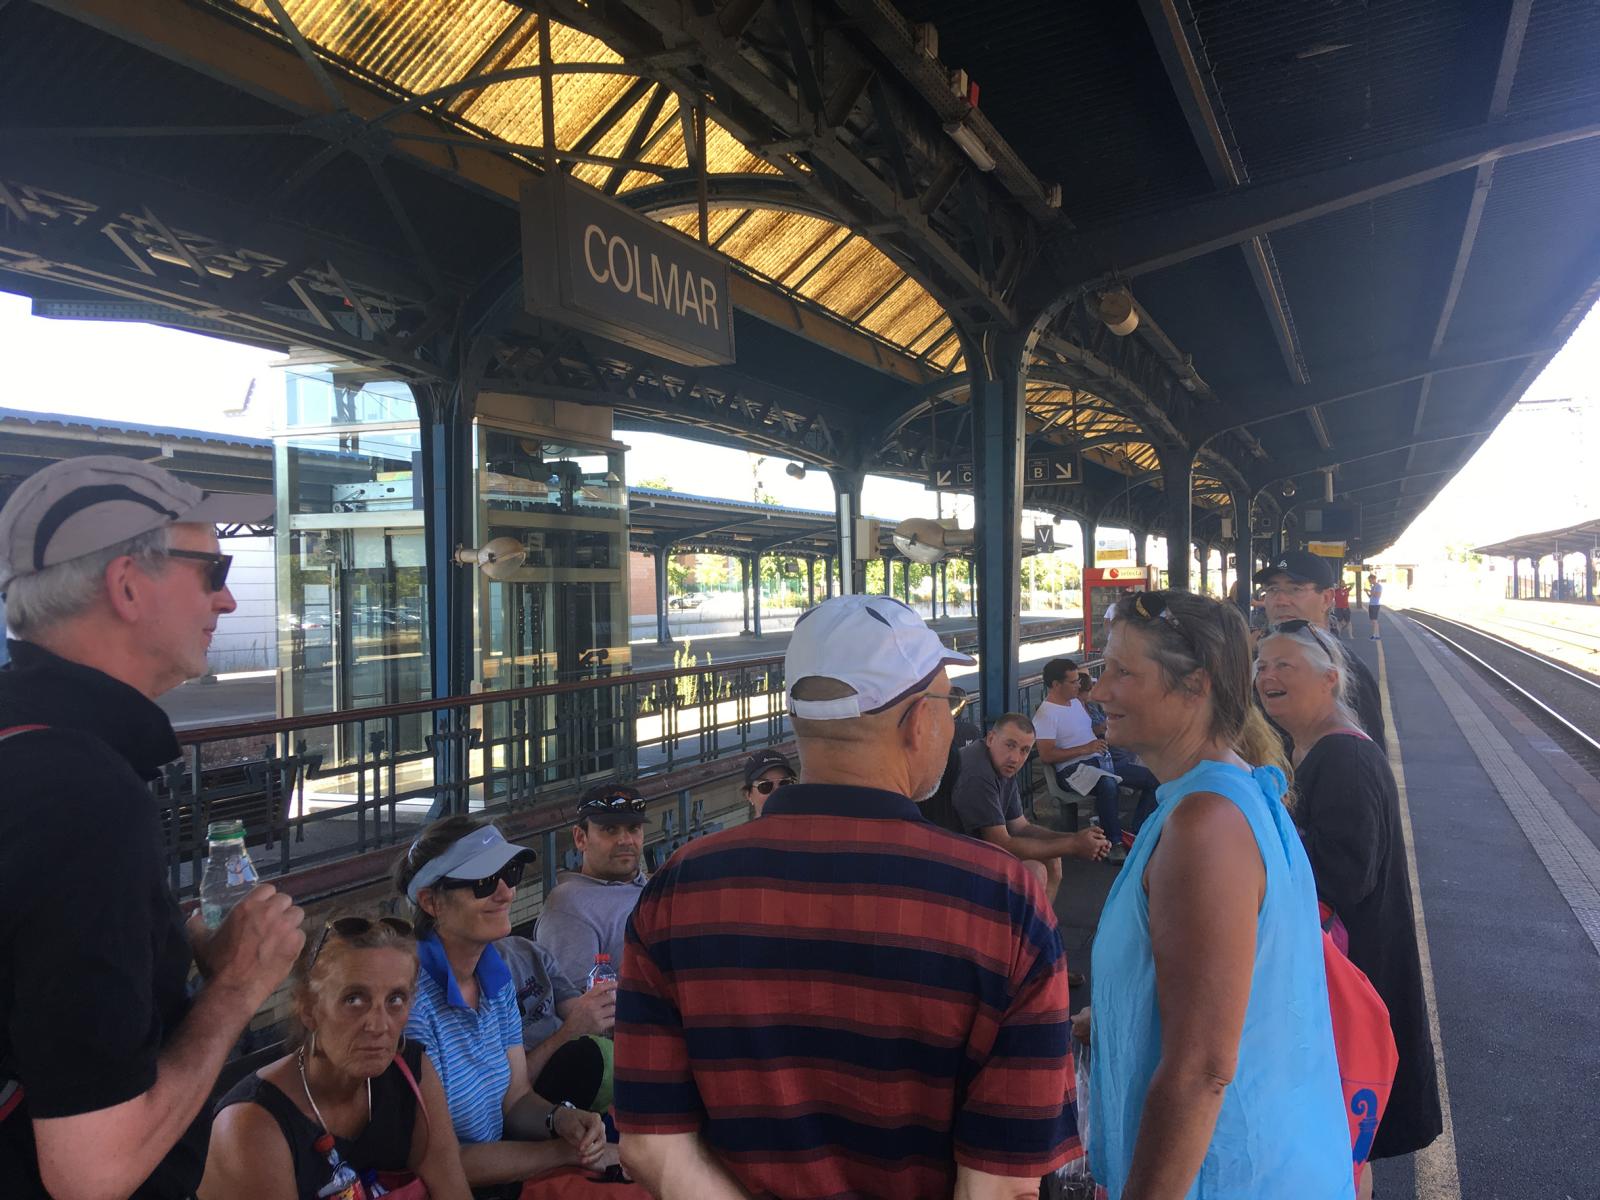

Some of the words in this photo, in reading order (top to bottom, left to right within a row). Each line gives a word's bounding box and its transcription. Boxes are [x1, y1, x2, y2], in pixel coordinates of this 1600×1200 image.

[584, 224, 719, 330] COLMAR
[963, 471, 972, 482] C
[1034, 467, 1043, 479] B
[1038, 529, 1050, 543] V
